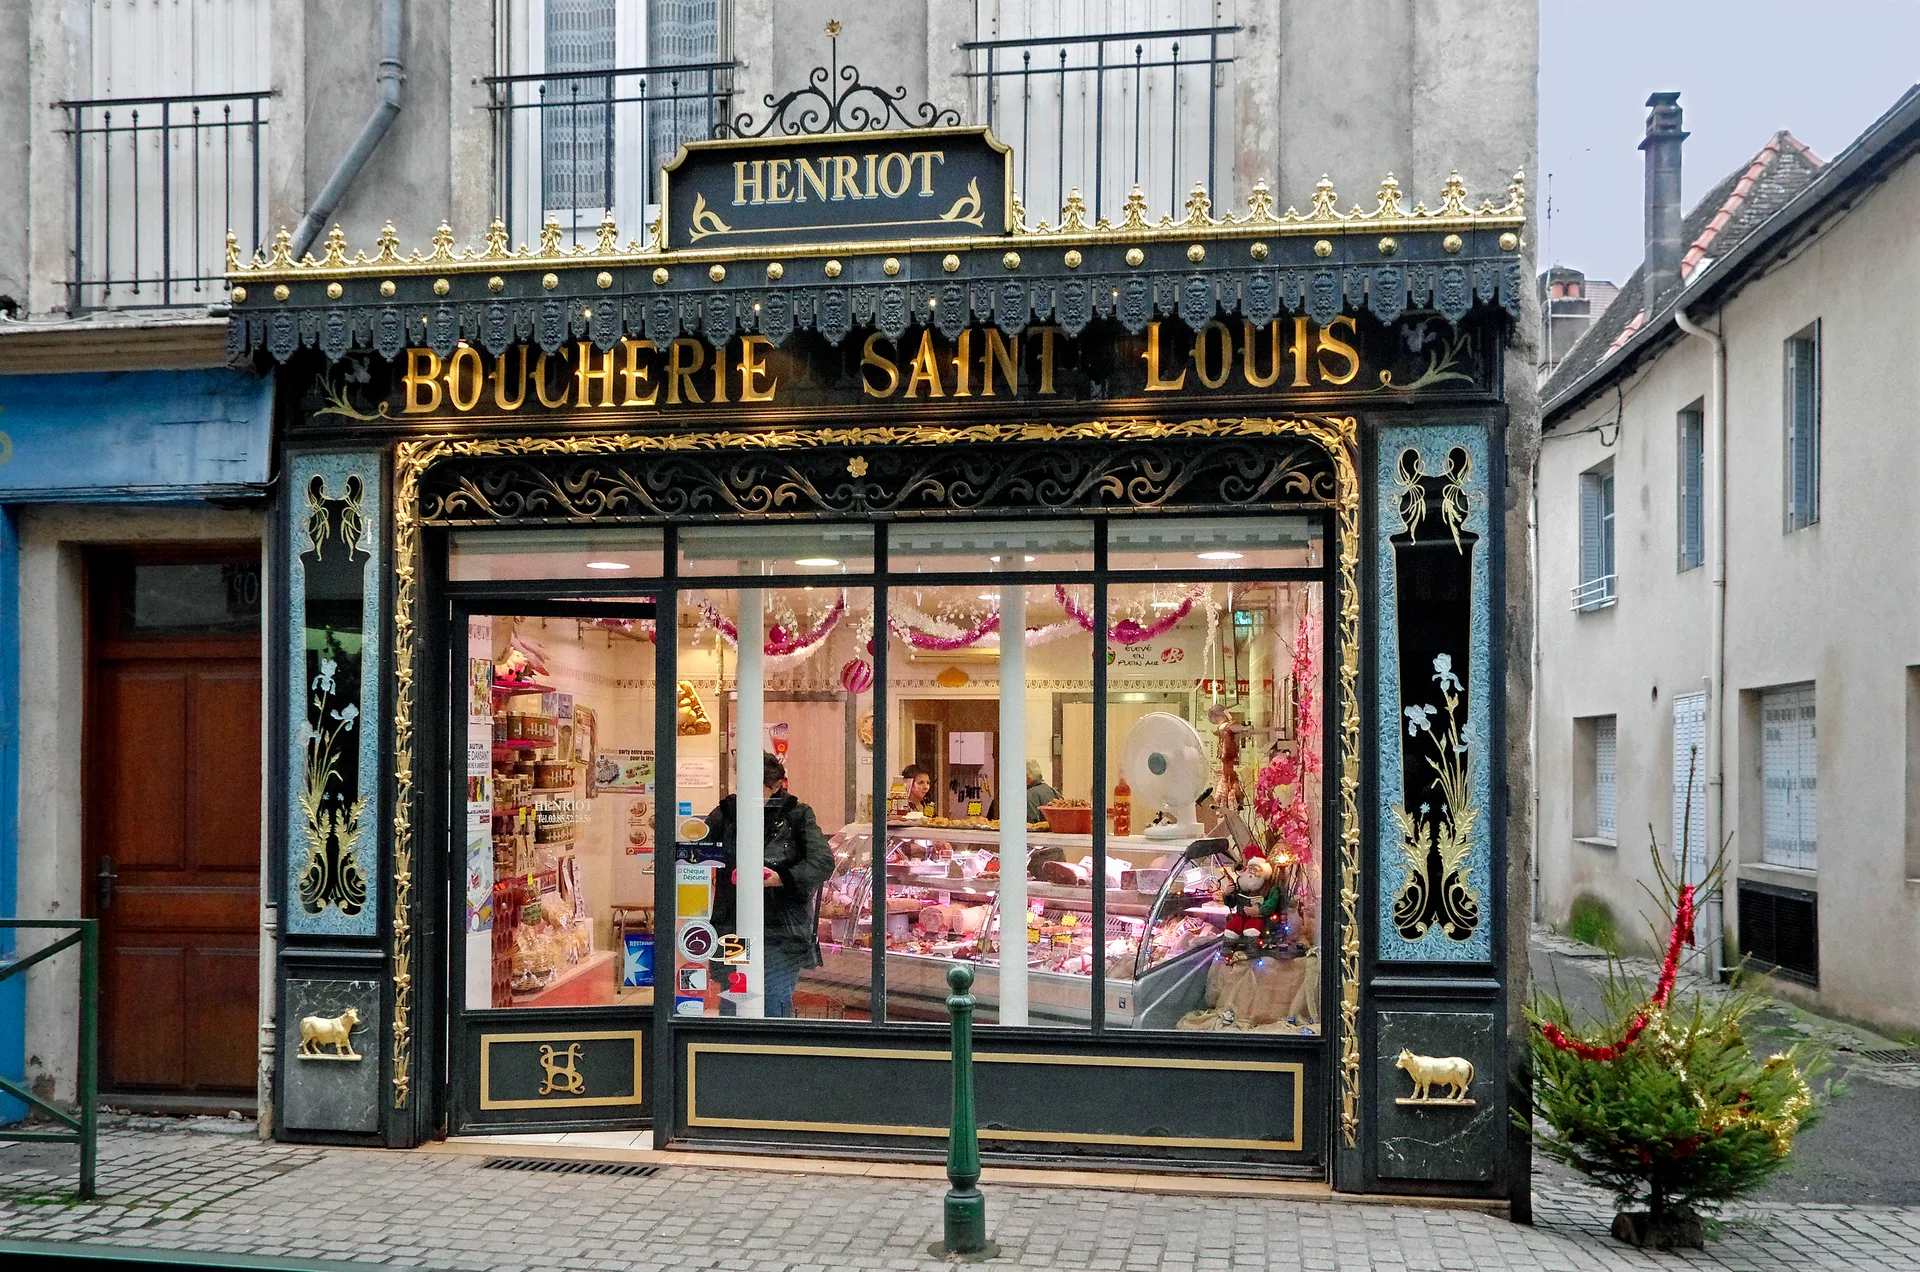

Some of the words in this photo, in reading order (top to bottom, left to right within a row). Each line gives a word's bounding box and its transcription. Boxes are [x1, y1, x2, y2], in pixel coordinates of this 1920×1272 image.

[732, 151, 945, 206] HENRIOT
[401, 335, 779, 414] BOUCHERIE
[860, 326, 1070, 399] SAINT
[1141, 315, 1361, 392] LOUIS
[535, 800, 593, 812] HENRIOT
